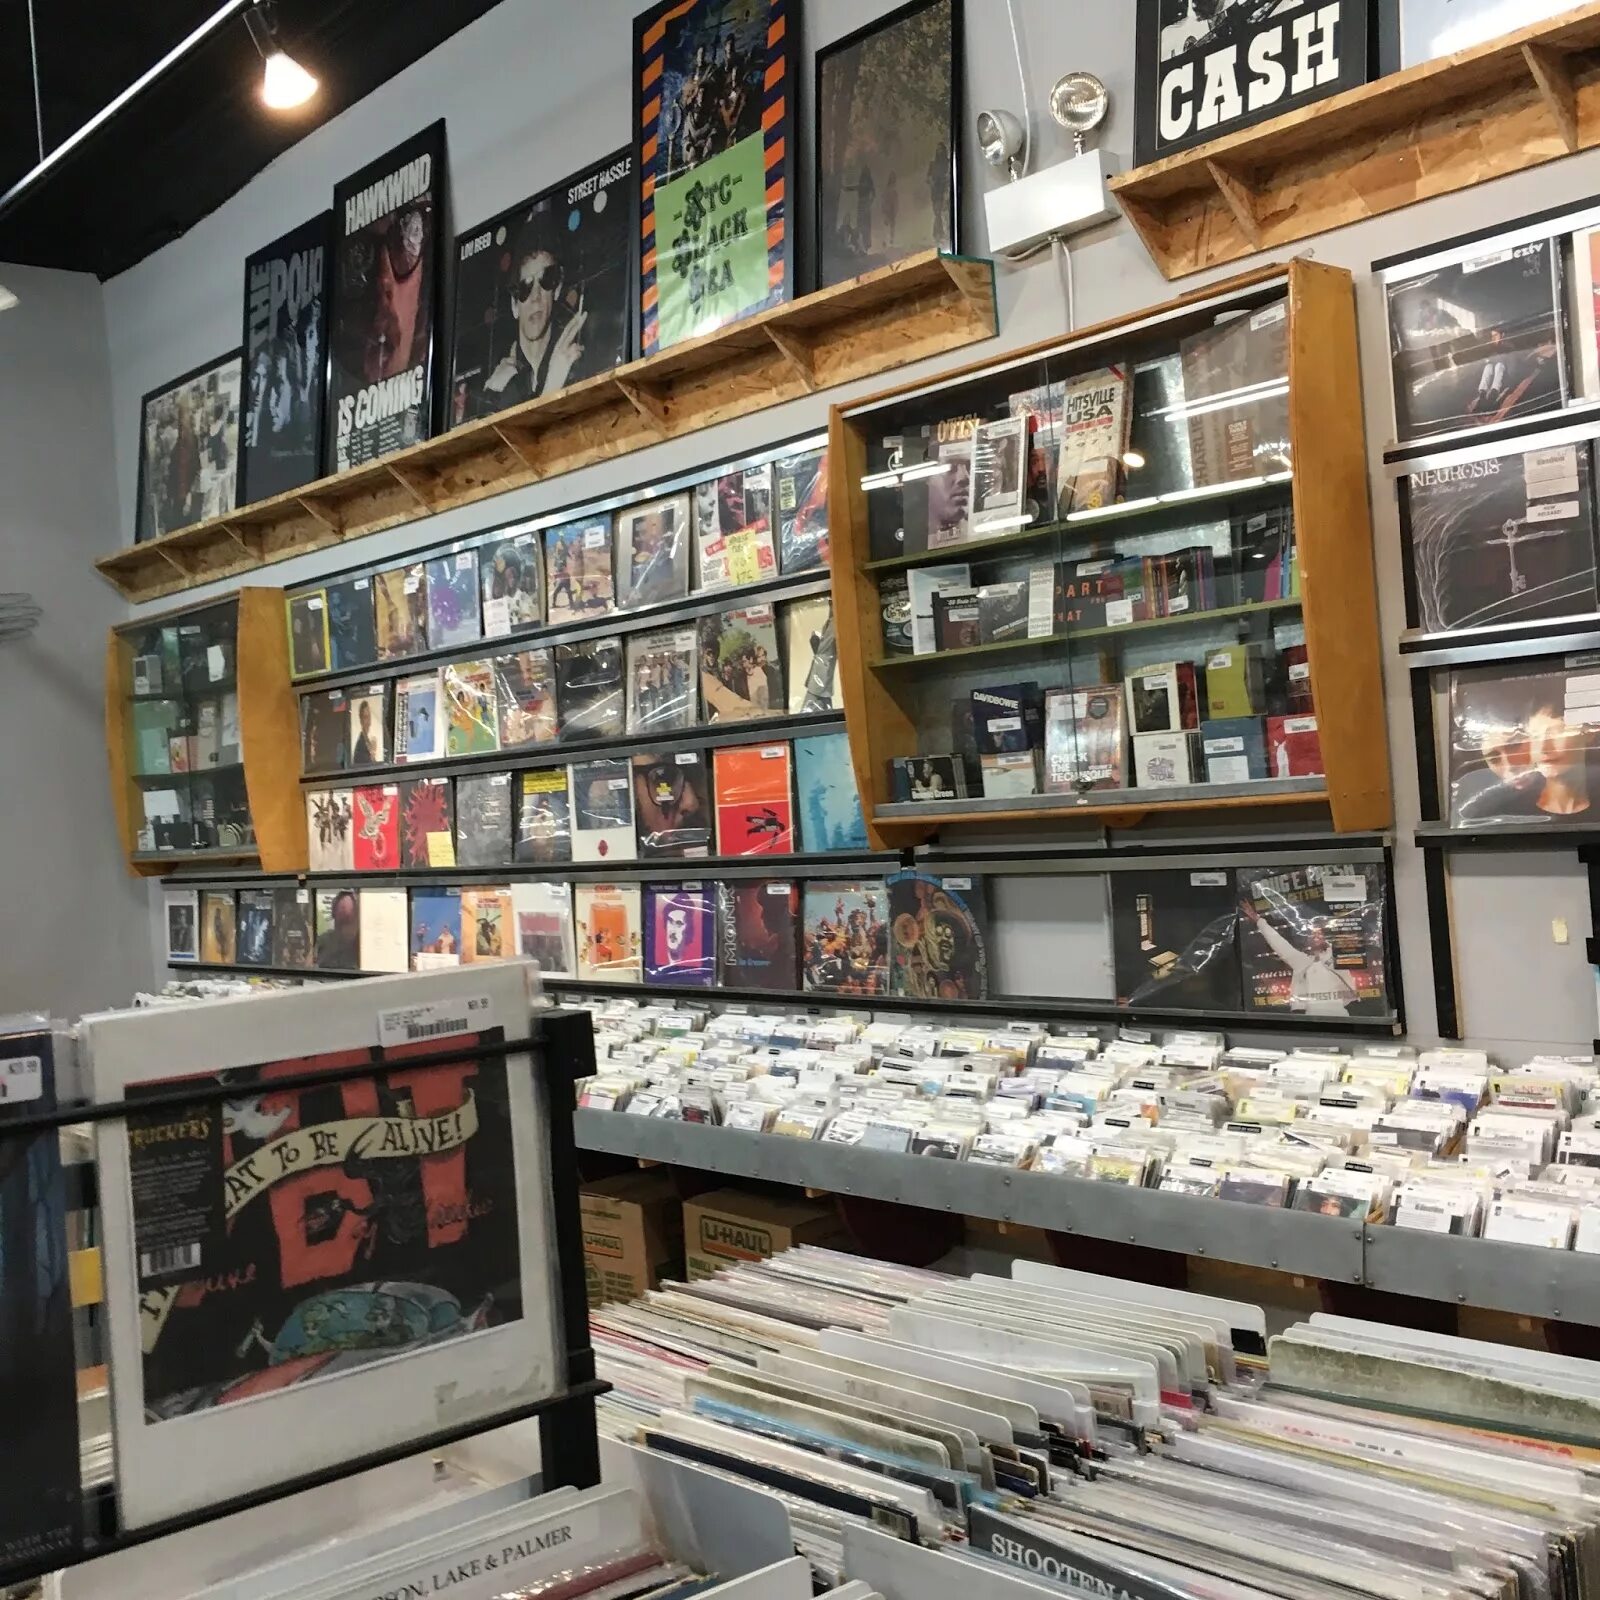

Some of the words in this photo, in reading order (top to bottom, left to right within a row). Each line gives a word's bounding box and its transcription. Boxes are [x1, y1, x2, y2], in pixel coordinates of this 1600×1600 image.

[1159, 1, 1340, 141] CASH
[345, 153, 431, 236] HAWKWIND
[567, 174, 599, 205] STREET
[598, 157, 632, 189] HASSLE
[461, 239, 474, 261] LOU
[474, 231, 492, 254] REED
[337, 394, 356, 437] IS
[354, 365, 424, 429] COMING
[1066, 405, 1113, 425] USA
[1067, 387, 1115, 414] HITSVILLE
[1410, 458, 1502, 489] NEUROSIS
[1051, 763, 1071, 774] THE
[309, 1131, 340, 1159] BE
[704, 1222, 768, 1255] U-HAUL
[432, 1559, 482, 1591] LAKE
[484, 1554, 499, 1571] &
[501, 1525, 573, 1565] PALMER
